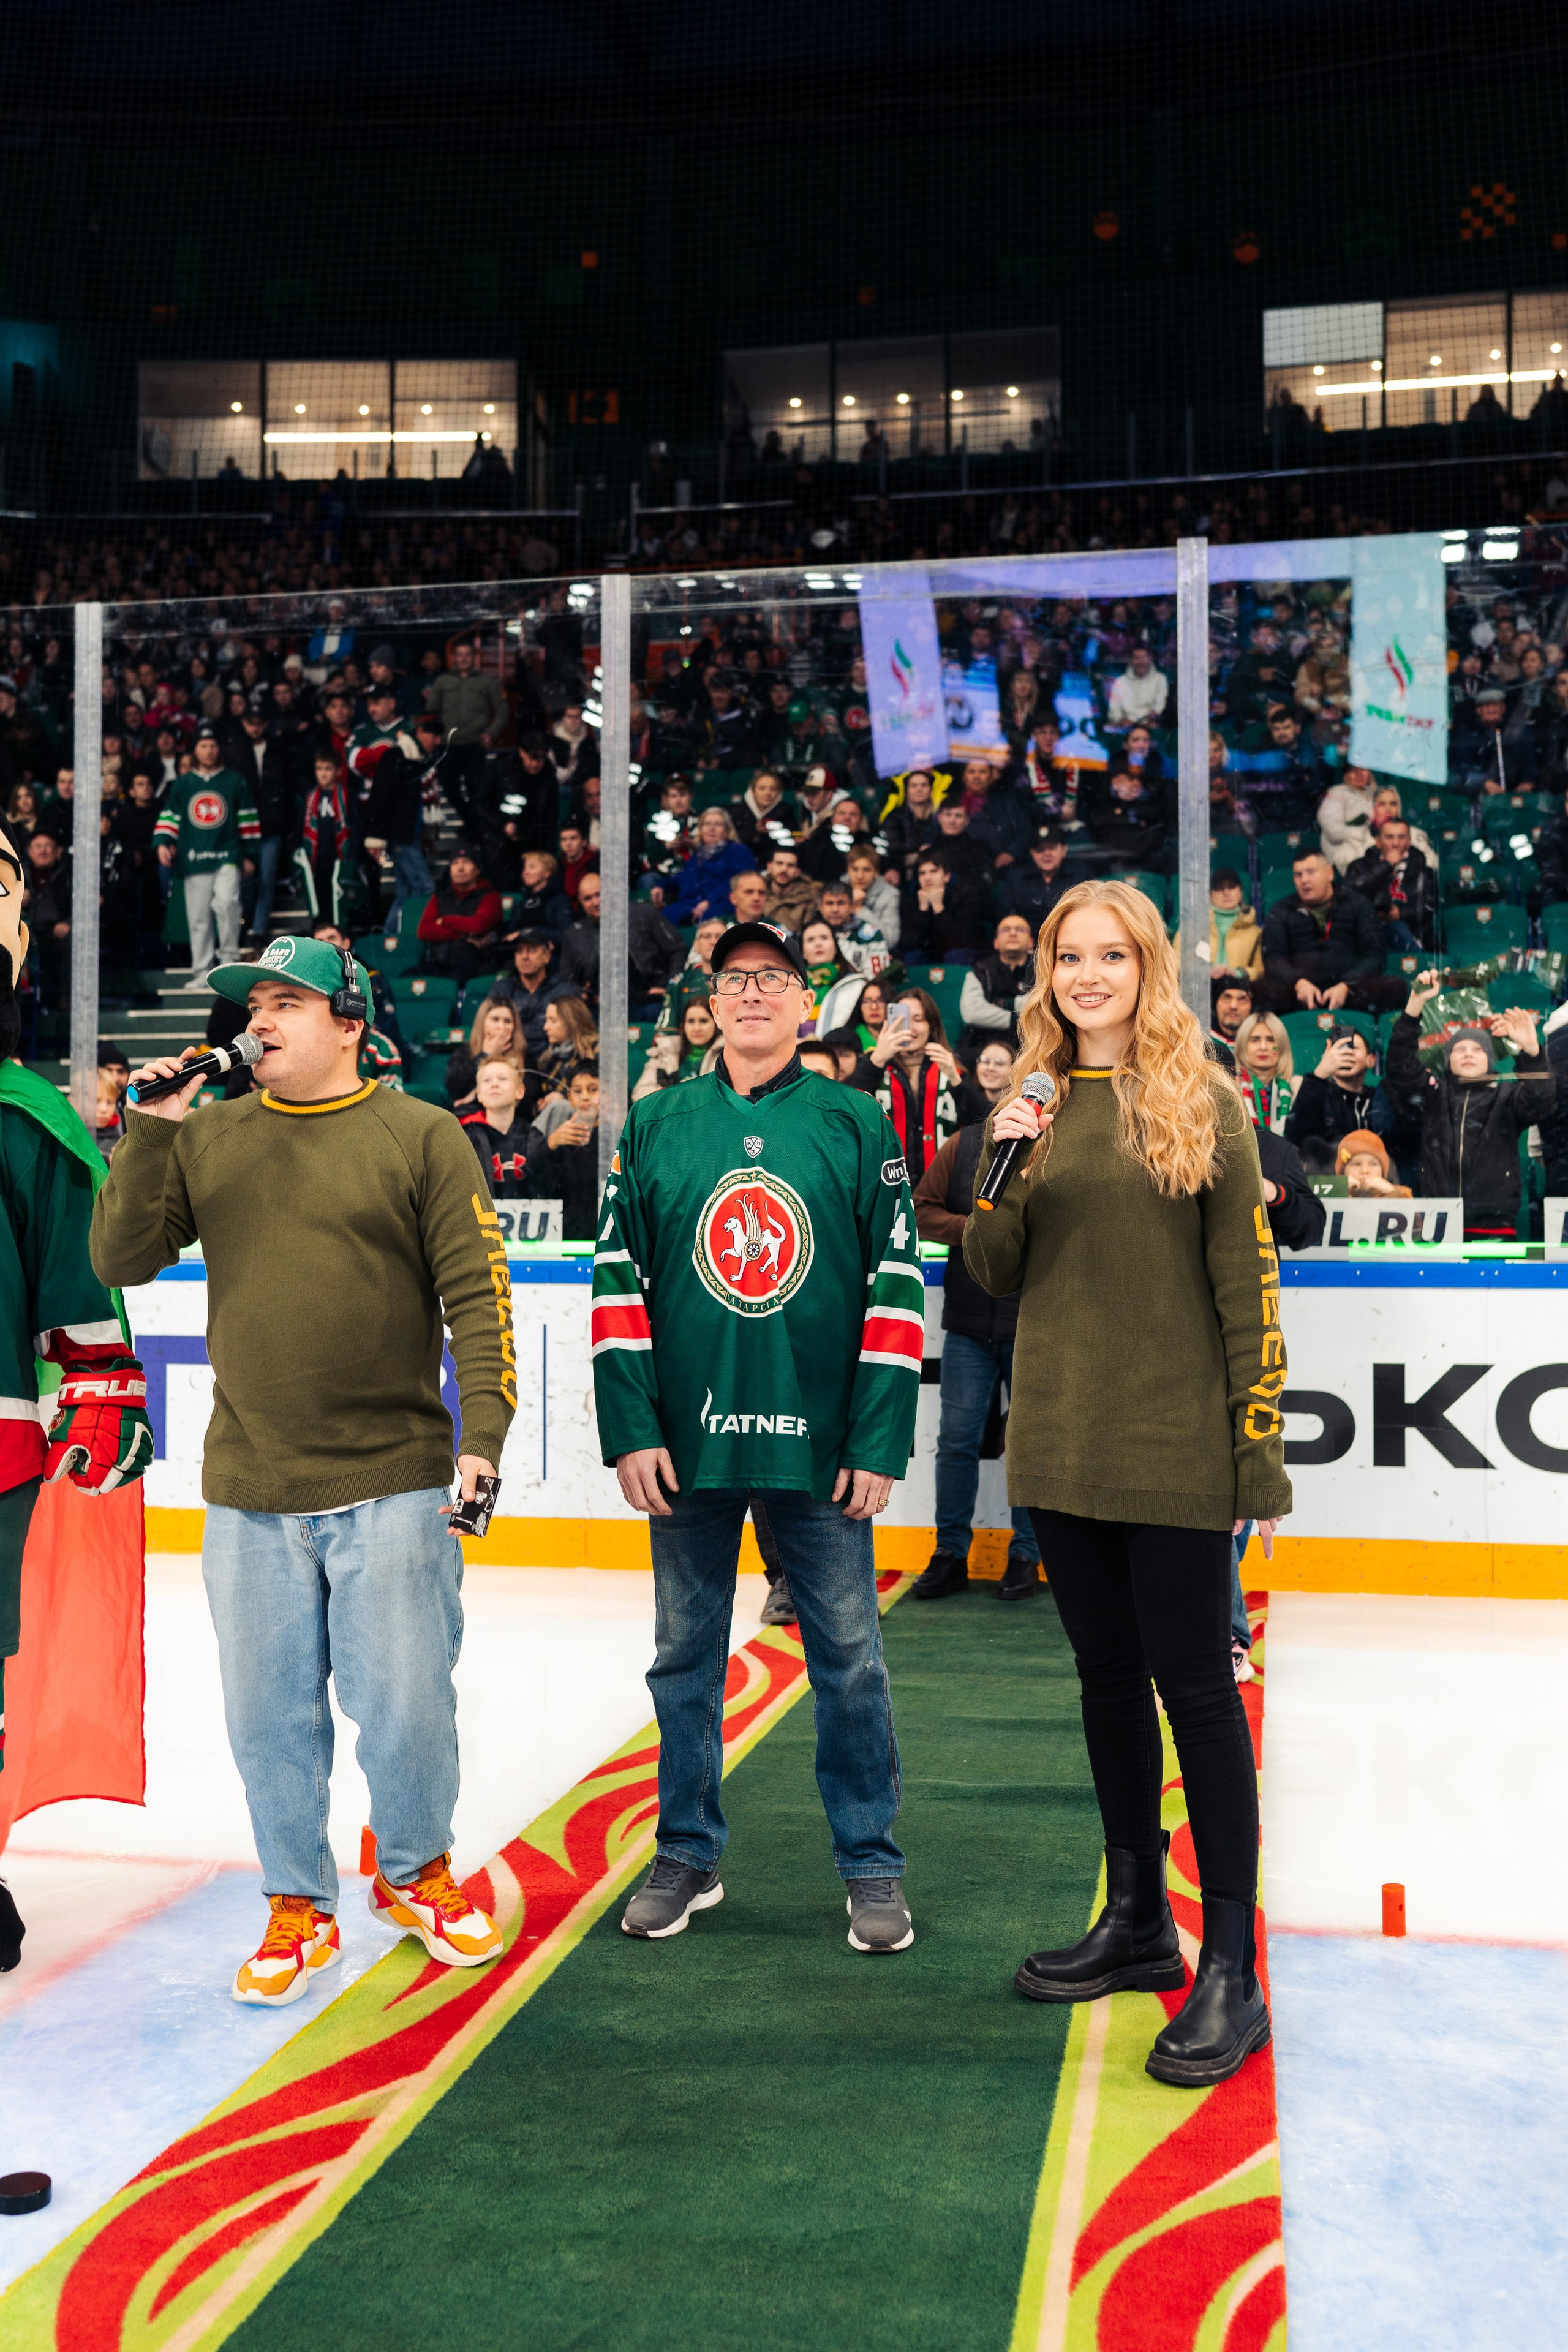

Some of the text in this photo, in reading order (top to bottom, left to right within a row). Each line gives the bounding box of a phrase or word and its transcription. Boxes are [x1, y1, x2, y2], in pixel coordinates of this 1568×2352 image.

[1243, 1205, 1287, 1440] JAECOO
[59, 1379, 147, 1401] TRUE
[709, 1414, 810, 1439] TATNEF
